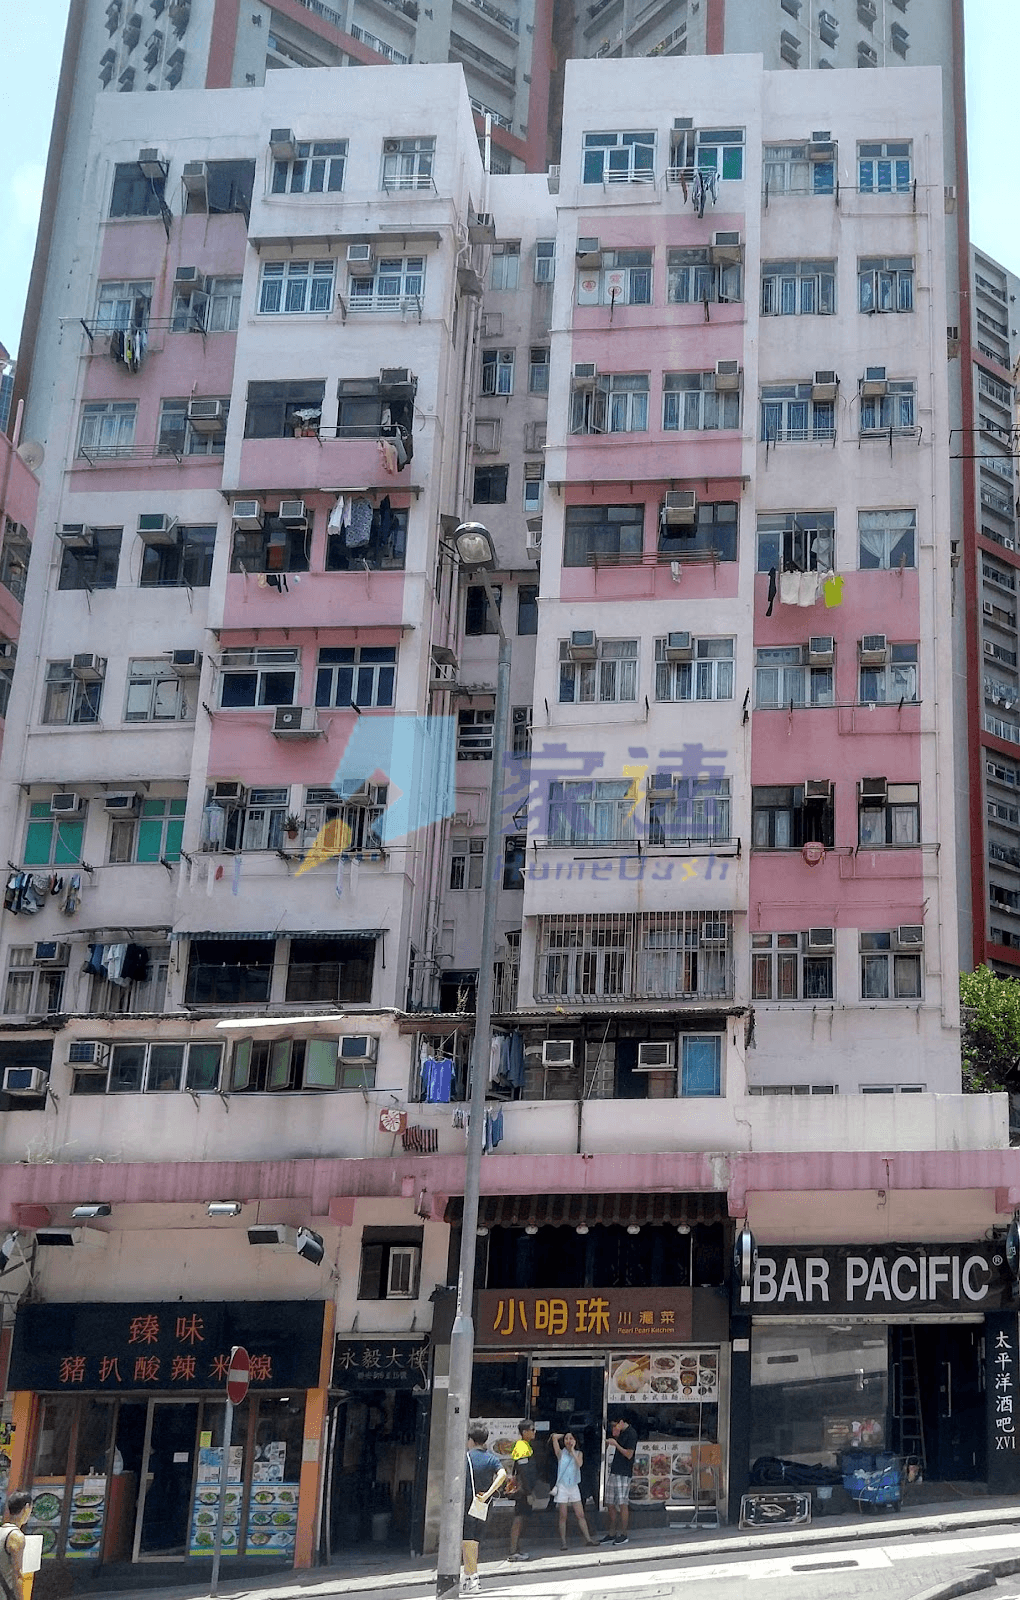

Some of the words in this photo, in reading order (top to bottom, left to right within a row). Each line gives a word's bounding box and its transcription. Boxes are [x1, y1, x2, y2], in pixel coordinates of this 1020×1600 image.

[753, 1257, 830, 1302] BAR
[846, 1255, 989, 1301] PACIFIC
[128, 1313, 205, 1345] 臻味
[493, 1297, 610, 1335] 小明珠
[618, 1310, 675, 1325] 川滬菜
[59, 1354, 273, 1383] 豬扒酸辣米線
[339, 1346, 429, 1370] 永毅大樓
[994, 1330, 1015, 1433] 太平洋酒吧
[995, 1436, 1015, 1450] XVI
